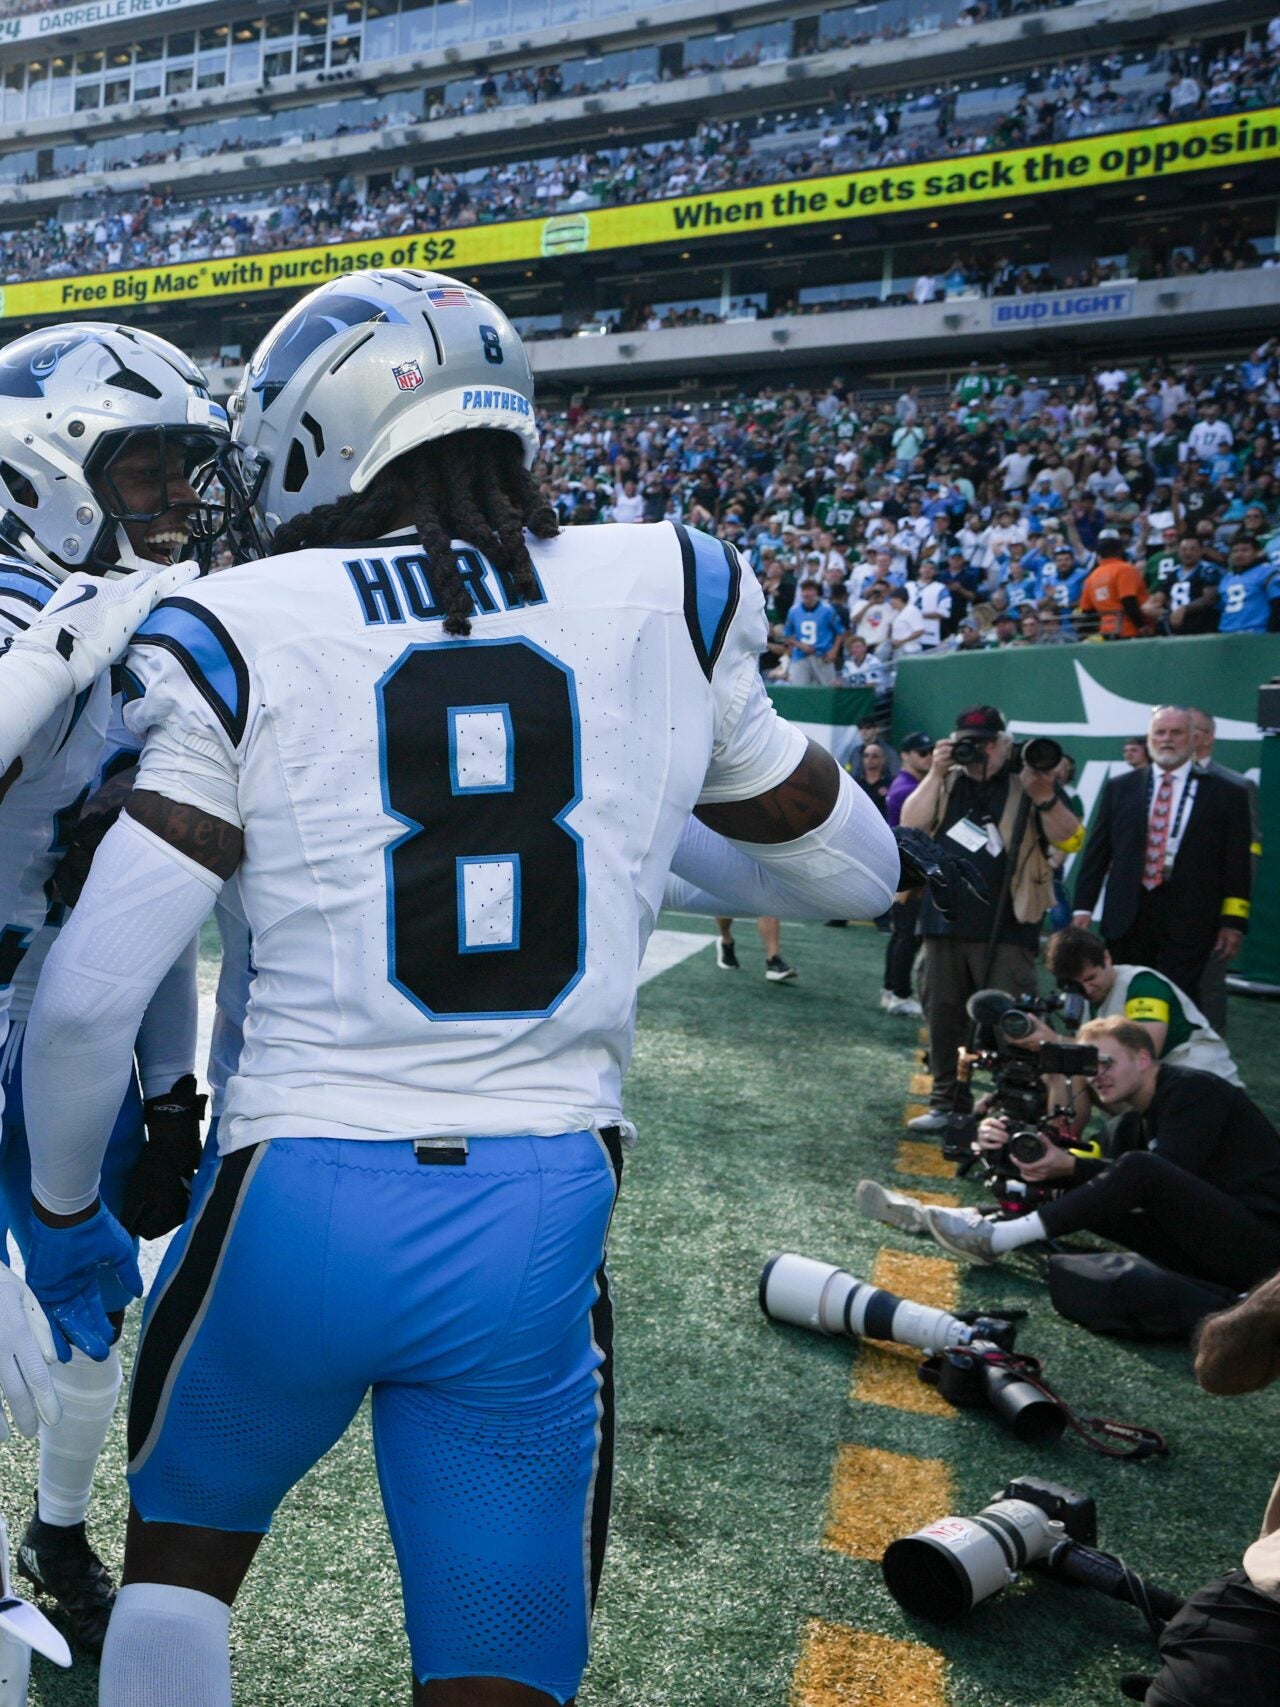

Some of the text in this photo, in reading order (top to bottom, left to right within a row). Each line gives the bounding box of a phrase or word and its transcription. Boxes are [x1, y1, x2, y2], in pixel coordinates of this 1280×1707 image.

[39, 1, 126, 32] DARRELLE
[130, 0, 180, 13] REV
[673, 200, 764, 230] When
[772, 189, 828, 217] the
[835, 177, 916, 209] Jets
[924, 161, 1014, 197] sack
[1023, 153, 1090, 183] the
[62, 284, 107, 303] Free
[113, 275, 148, 301] Big
[211, 262, 264, 287] with
[269, 249, 384, 289] purchase
[390, 241, 416, 266] of
[423, 238, 457, 266] $2
[998, 294, 1126, 321] BUD LIGHT
[478, 324, 504, 365] 8
[397, 371, 422, 389] NFL
[462, 390, 530, 416] PANTHERS
[800, 620, 818, 646] 9
[374, 634, 587, 1022] 8
